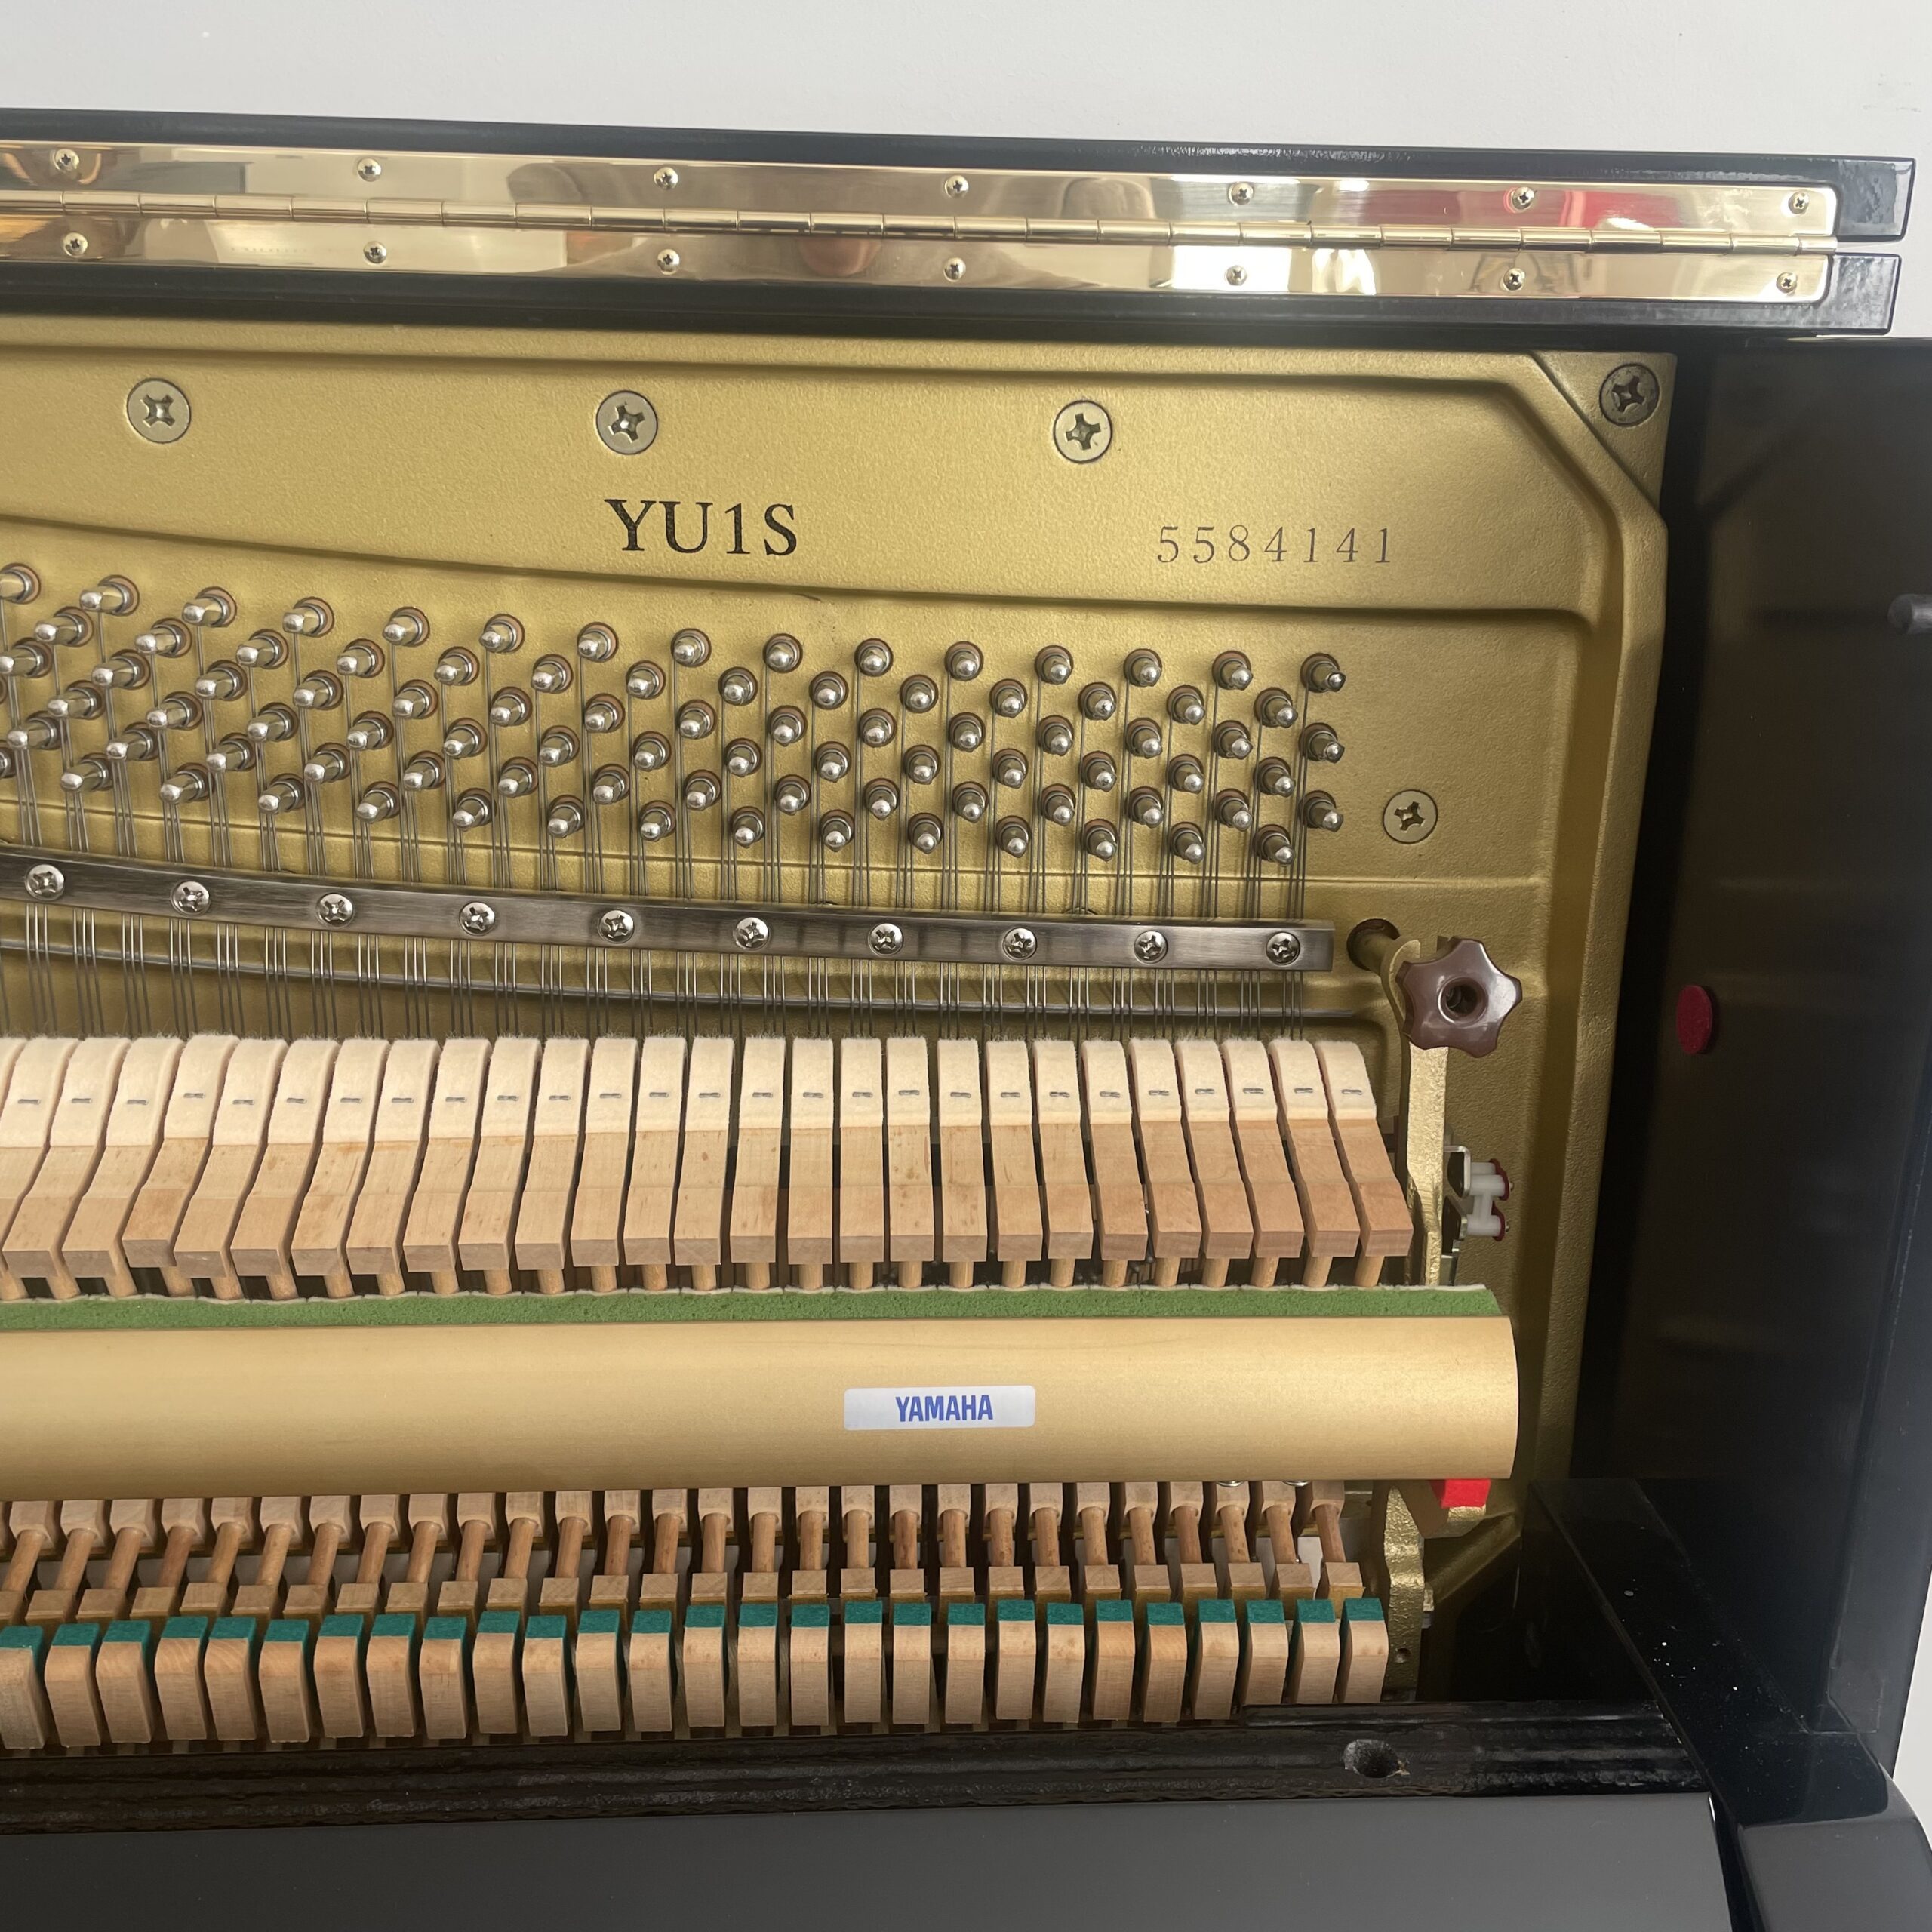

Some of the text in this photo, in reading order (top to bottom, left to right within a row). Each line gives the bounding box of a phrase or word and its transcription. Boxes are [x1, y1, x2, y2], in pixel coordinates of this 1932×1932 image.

[604, 499, 797, 556] YU1S
[1157, 525, 1391, 564] 5584141
[895, 1395, 993, 1422] YAMAHA
